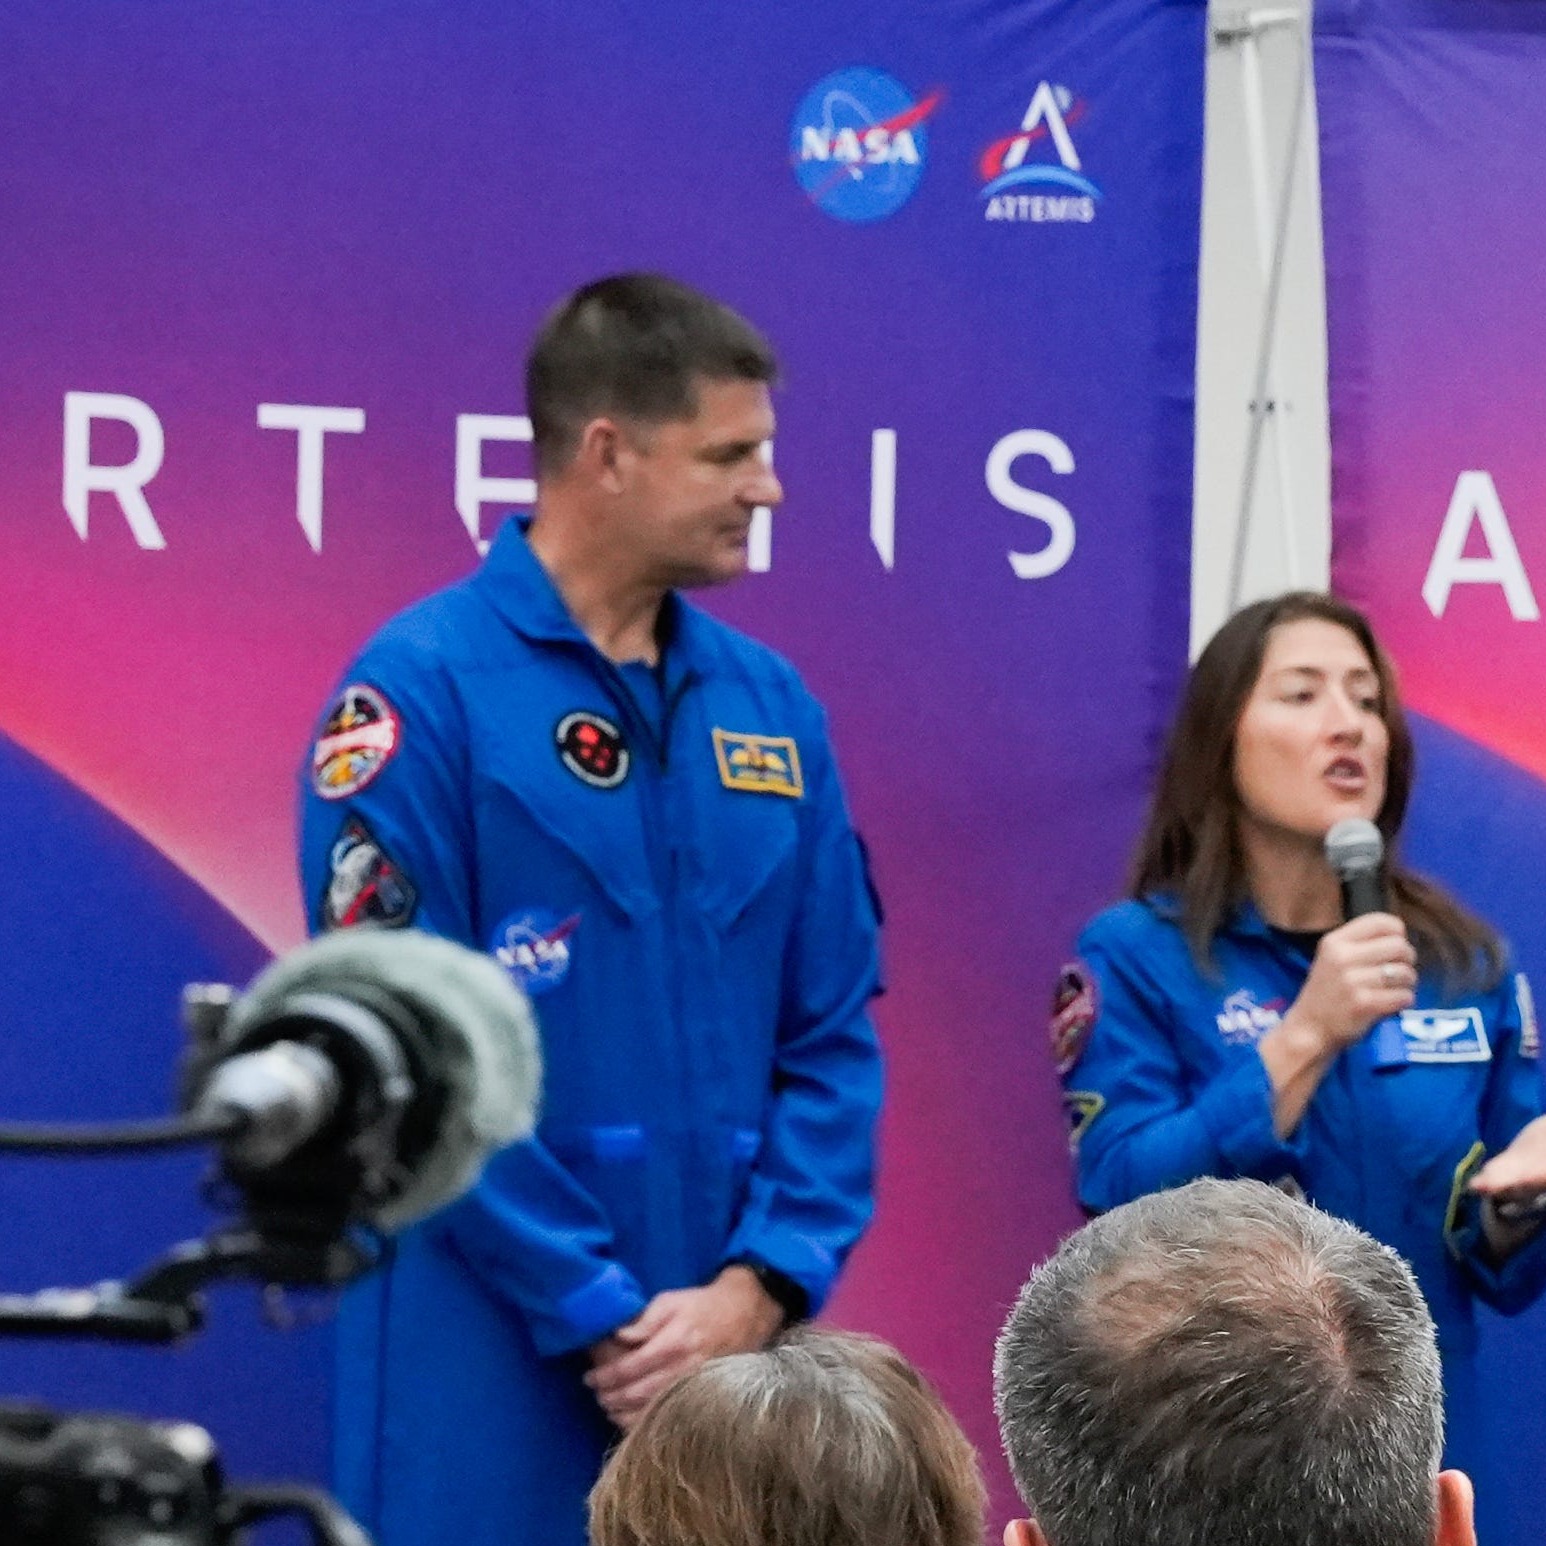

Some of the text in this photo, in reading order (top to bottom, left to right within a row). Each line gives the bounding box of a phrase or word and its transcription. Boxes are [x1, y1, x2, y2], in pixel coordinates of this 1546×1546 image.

[802, 127, 919, 165] NASA
[985, 196, 1095, 223] ARTEMIS
[62, 391, 1076, 580] RTEIS
